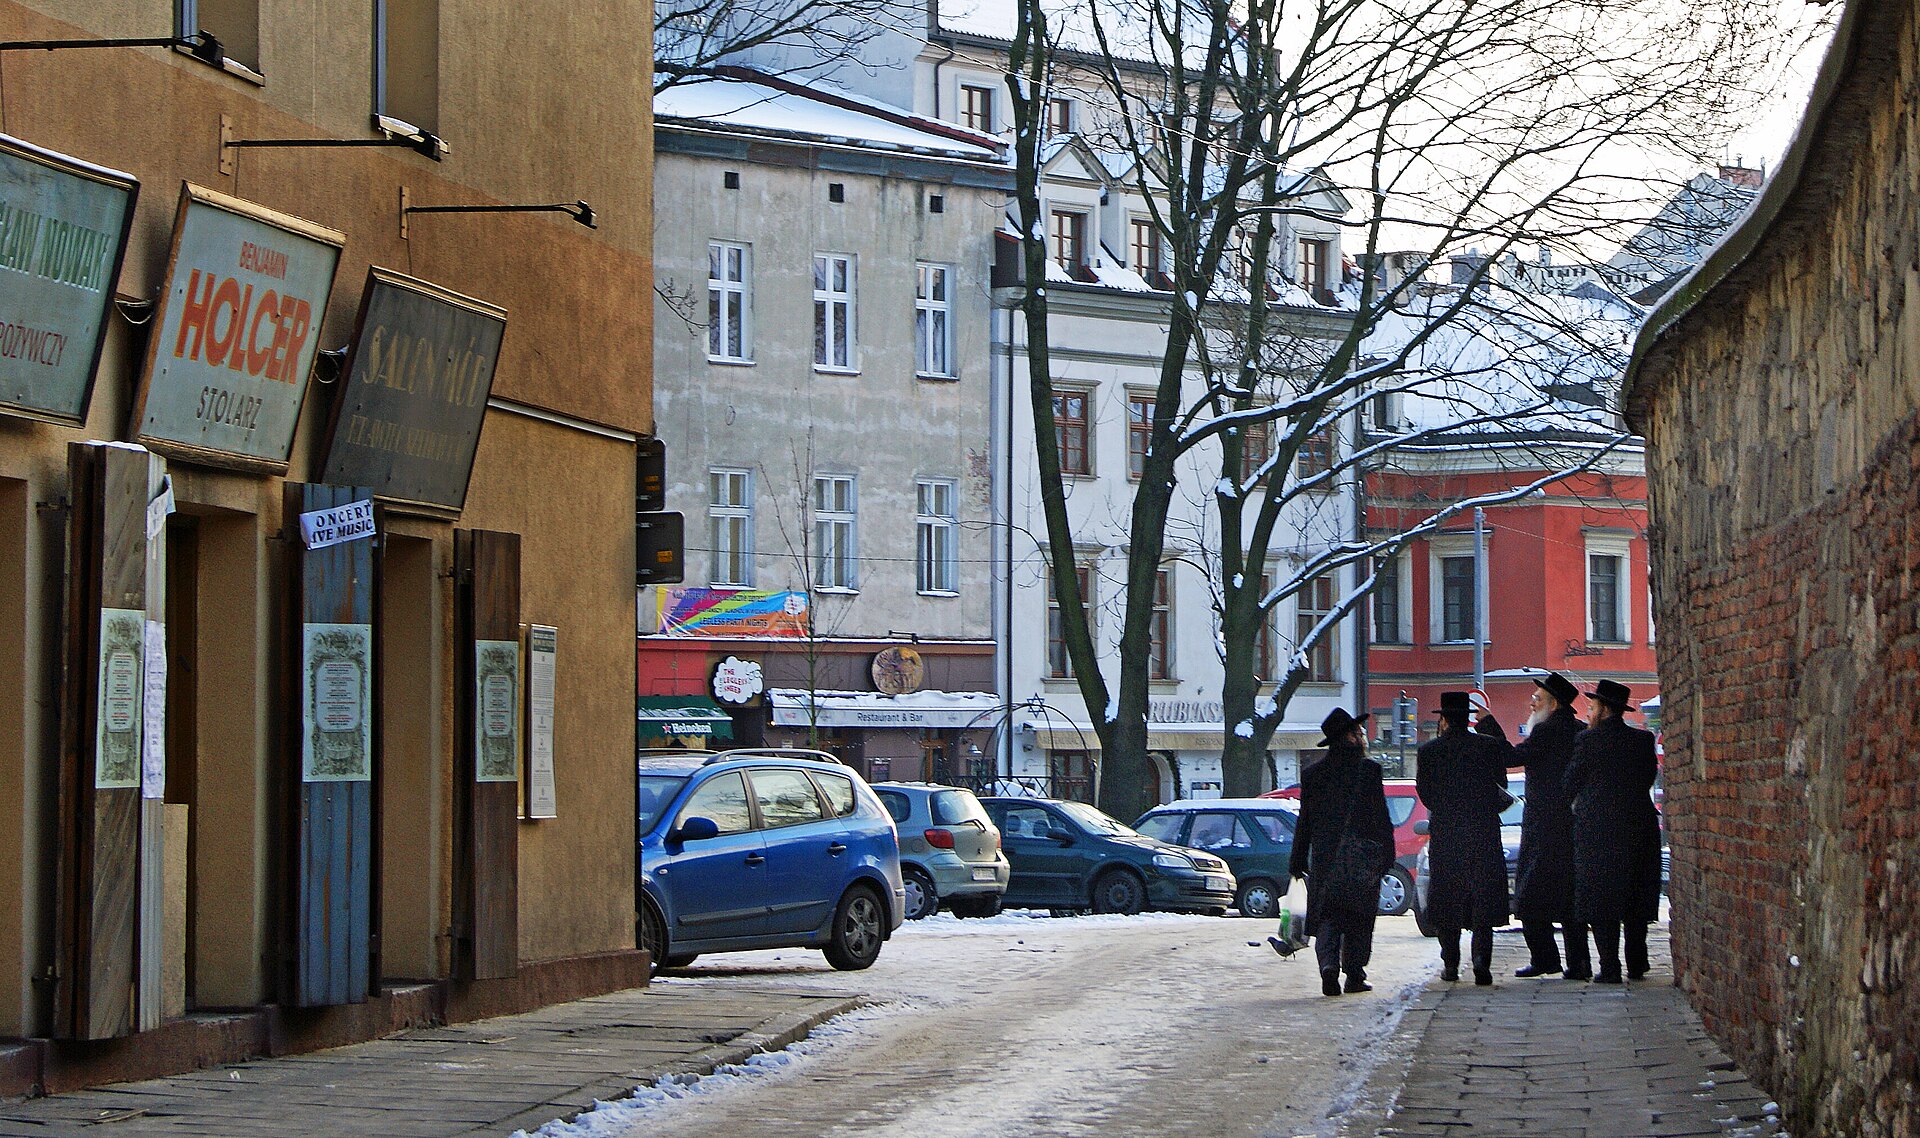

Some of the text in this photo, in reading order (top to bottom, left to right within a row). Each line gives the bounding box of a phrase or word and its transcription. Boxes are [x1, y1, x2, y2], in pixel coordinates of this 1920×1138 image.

[38, 217, 112, 293] NOWAK
[239, 240, 290, 281] BENJAMIN
[173, 268, 311, 385] HOLCER
[196, 386, 264, 431] STOLARZ
[336, 518, 373, 539] MUSIC
[723, 668, 735, 676] THE
[857, 712, 923, 722] Restaurant & Bar
[1149, 701, 1224, 723] RUBINS
[671, 722, 712, 734] Heineken
